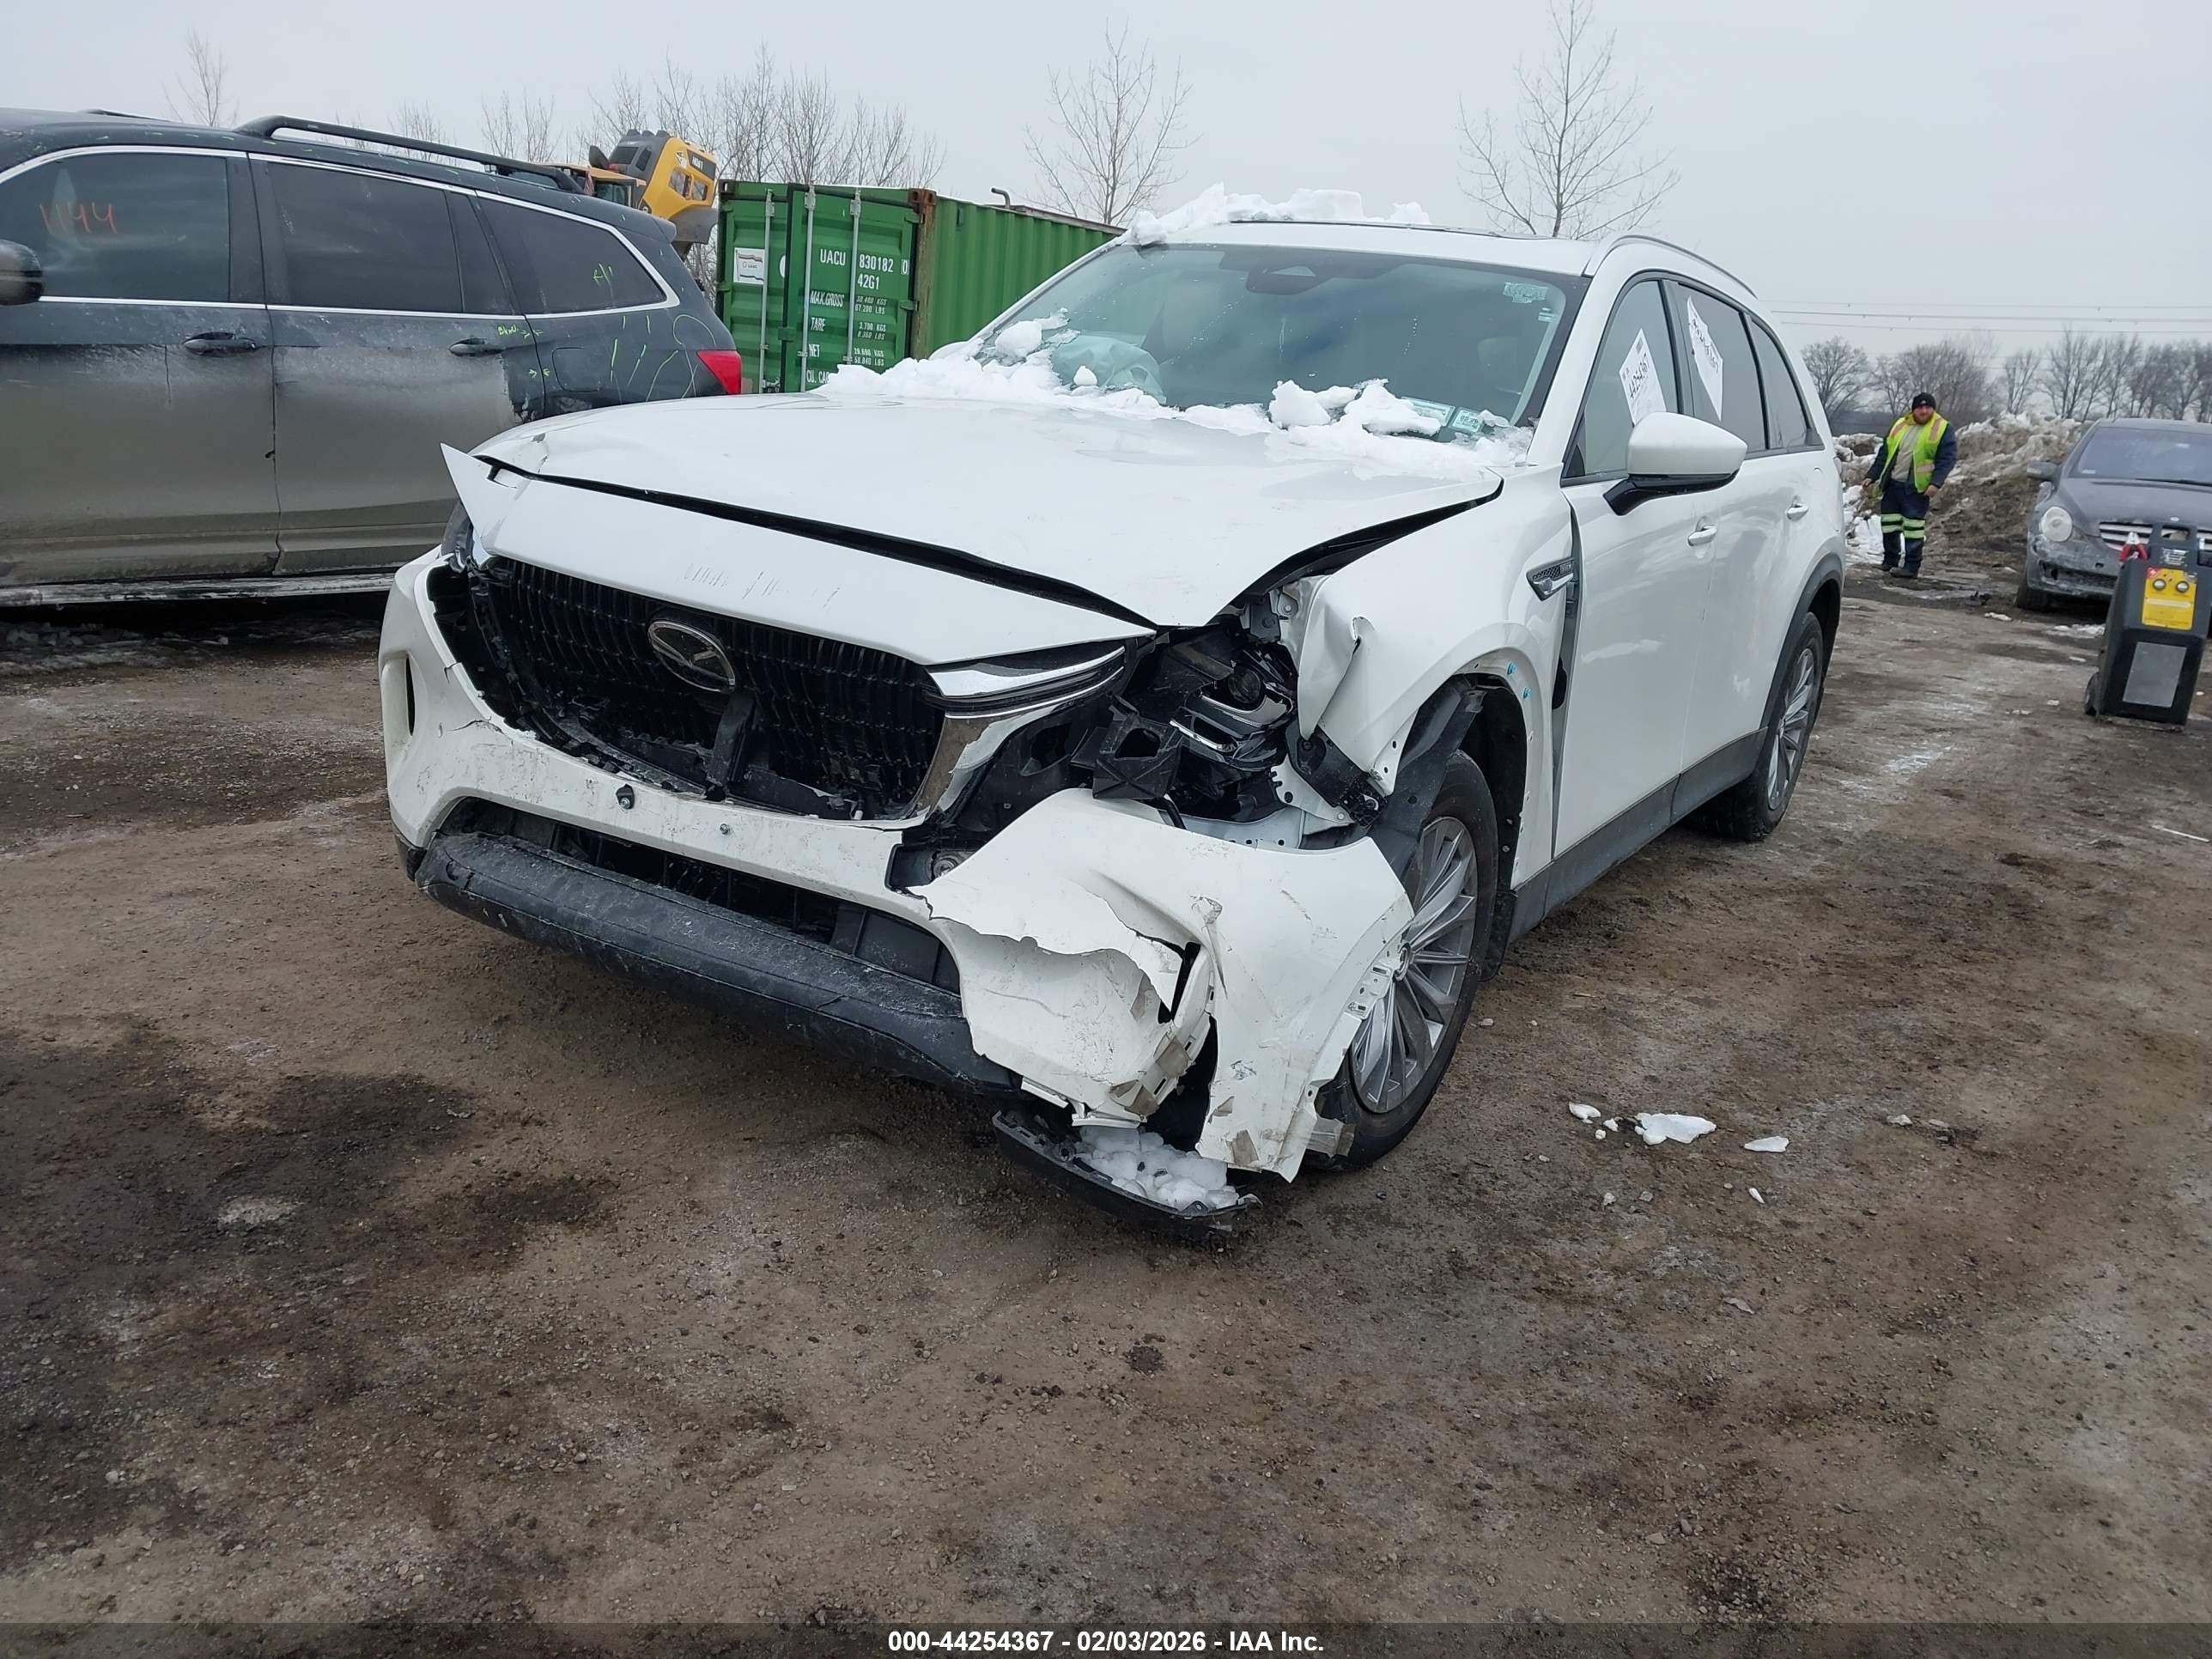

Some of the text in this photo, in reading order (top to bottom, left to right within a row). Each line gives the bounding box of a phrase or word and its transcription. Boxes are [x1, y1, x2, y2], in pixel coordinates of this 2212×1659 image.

[820, 249, 846, 265] UACU
[860, 254, 894, 272] 830182
[858, 274, 879, 289] 42G1
[810, 291, 845, 307] MAX.GROSS
[811, 317, 825, 331] TARE
[876, 324, 886, 332] KGS
[809, 343, 820, 357] NET
[874, 358, 884, 367] LBS
